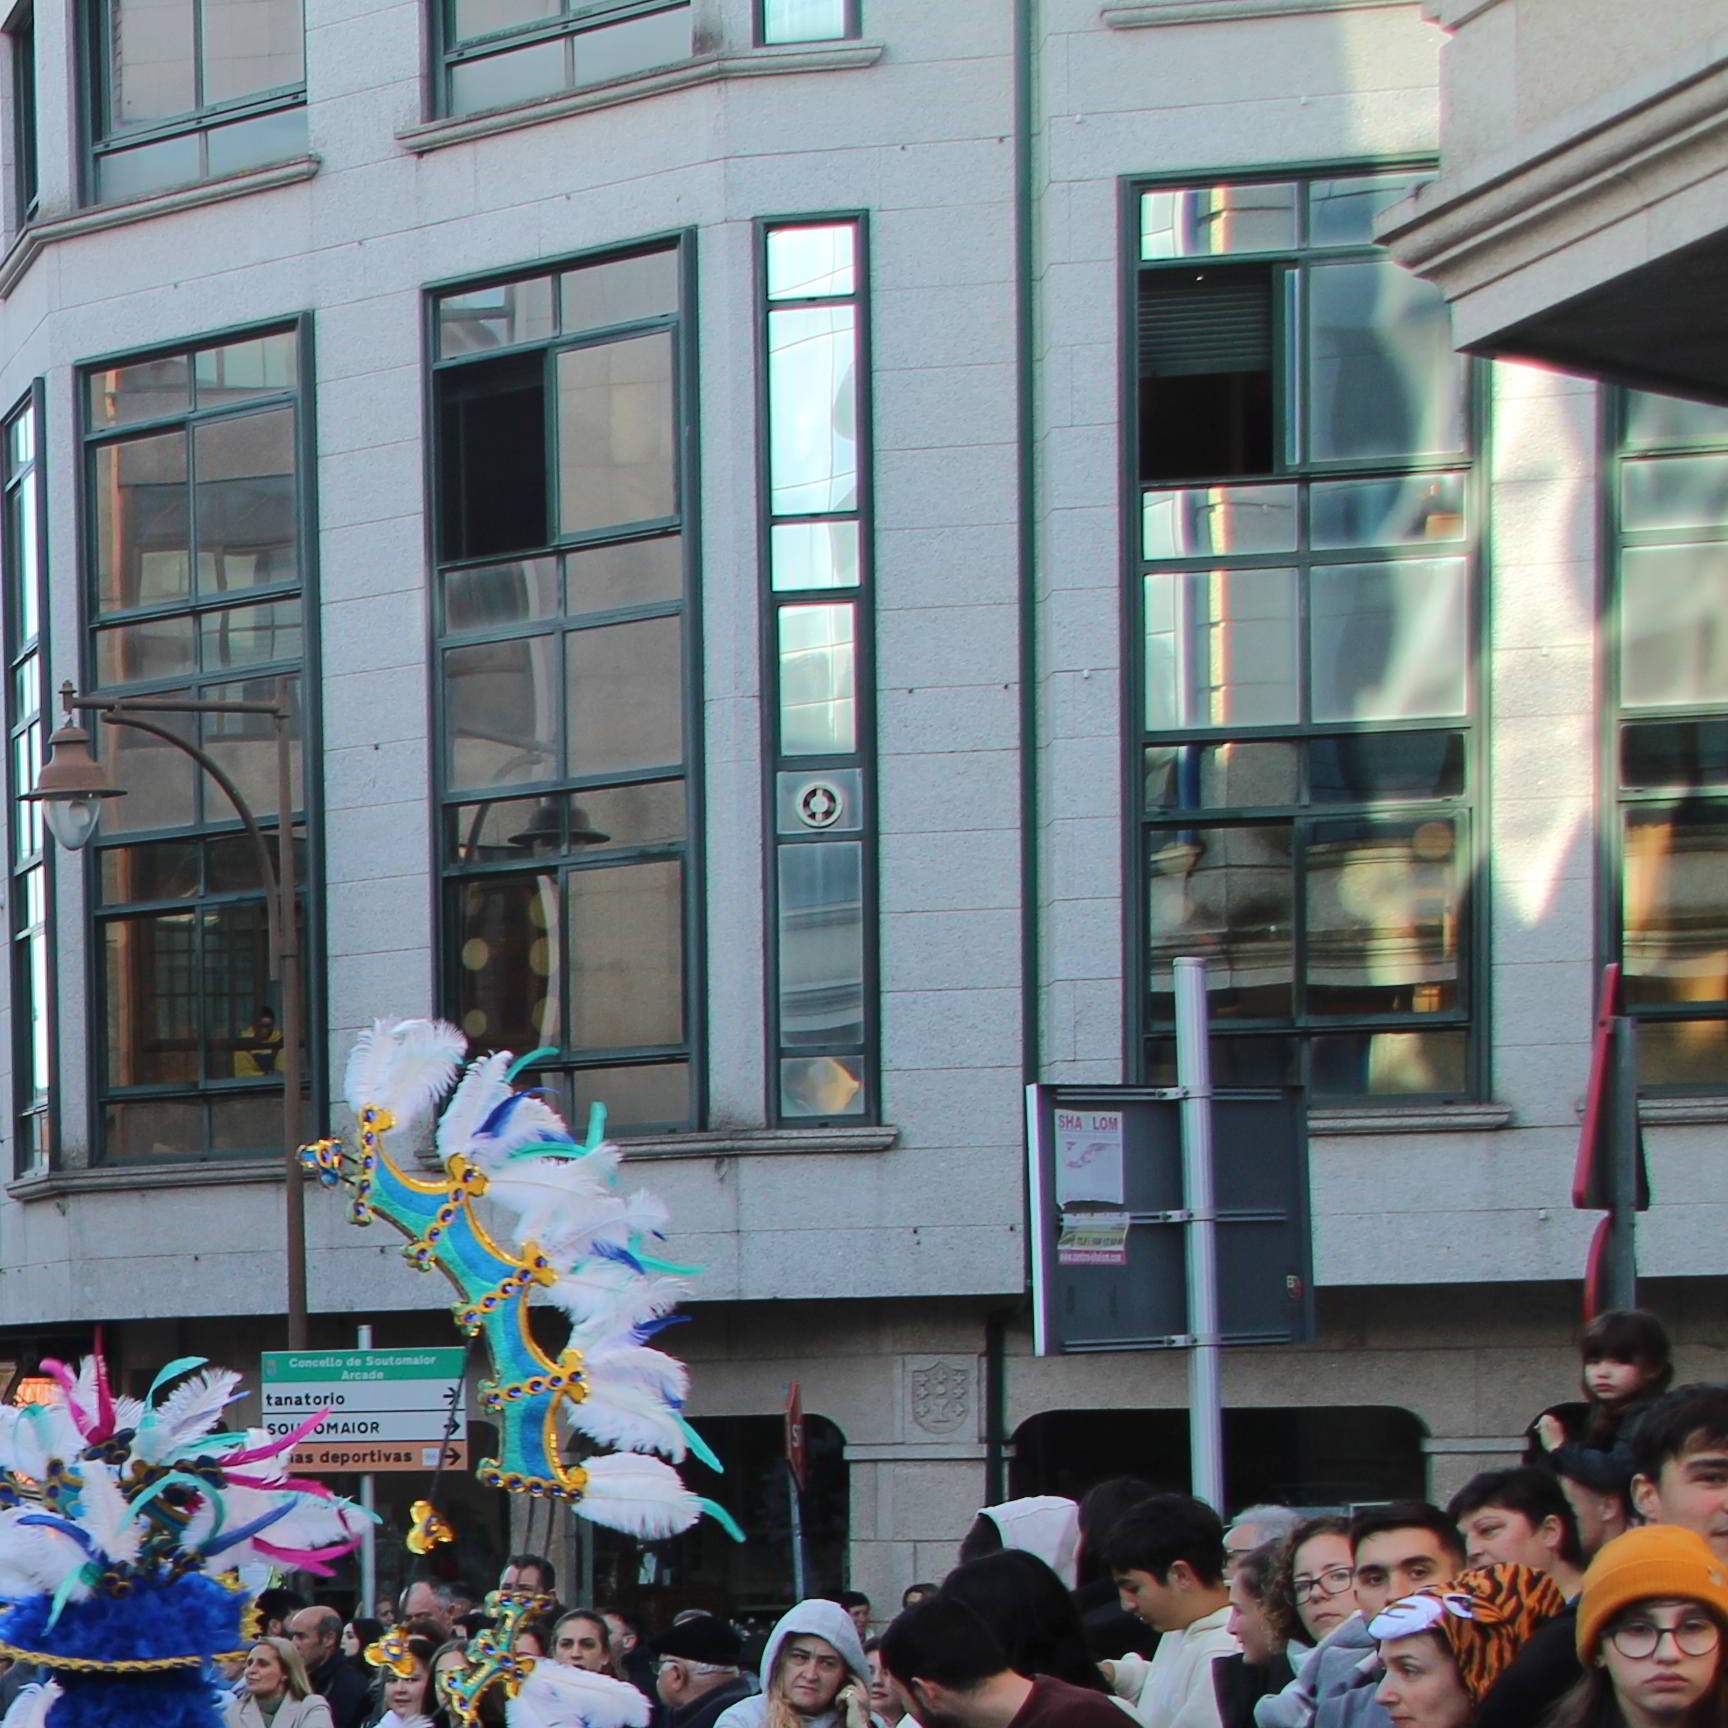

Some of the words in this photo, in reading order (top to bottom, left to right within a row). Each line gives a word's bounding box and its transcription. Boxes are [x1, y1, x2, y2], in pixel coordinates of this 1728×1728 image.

[1058, 1115, 1082, 1130] SHA
[1092, 1116, 1119, 1130] LOM
[289, 1356, 343, 1369] Concello
[346, 1356, 362, 1368] de
[365, 1354, 437, 1367] Soutomaior
[341, 1370, 385, 1381] Arcade
[266, 1392, 345, 1407] tanatorio
[290, 1452, 314, 1464] ias
[320, 1448, 412, 1466] deportivas
